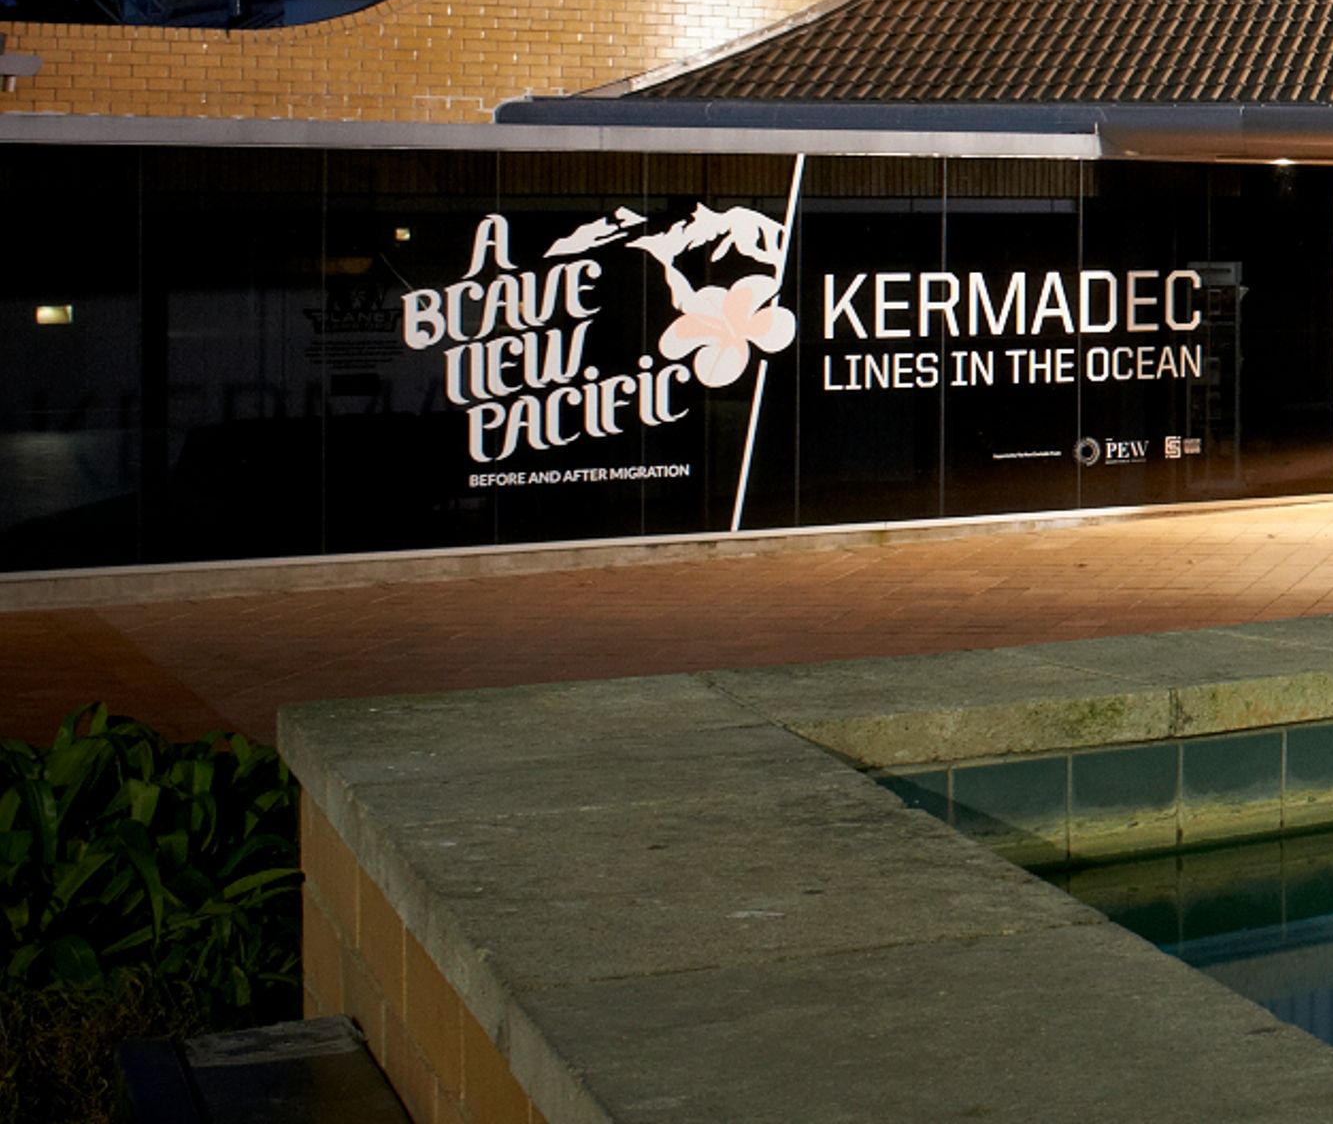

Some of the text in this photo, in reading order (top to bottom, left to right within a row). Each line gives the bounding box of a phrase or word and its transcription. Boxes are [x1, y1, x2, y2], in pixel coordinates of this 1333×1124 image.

[462, 214, 518, 280] A
[824, 270, 1202, 339] KERMADEC
[824, 344, 1202, 391] LINES IN THE OCEAN
[1105, 440, 1149, 459] PEW
[469, 464, 690, 487] BEFORE AND AFTER MIGRATION
